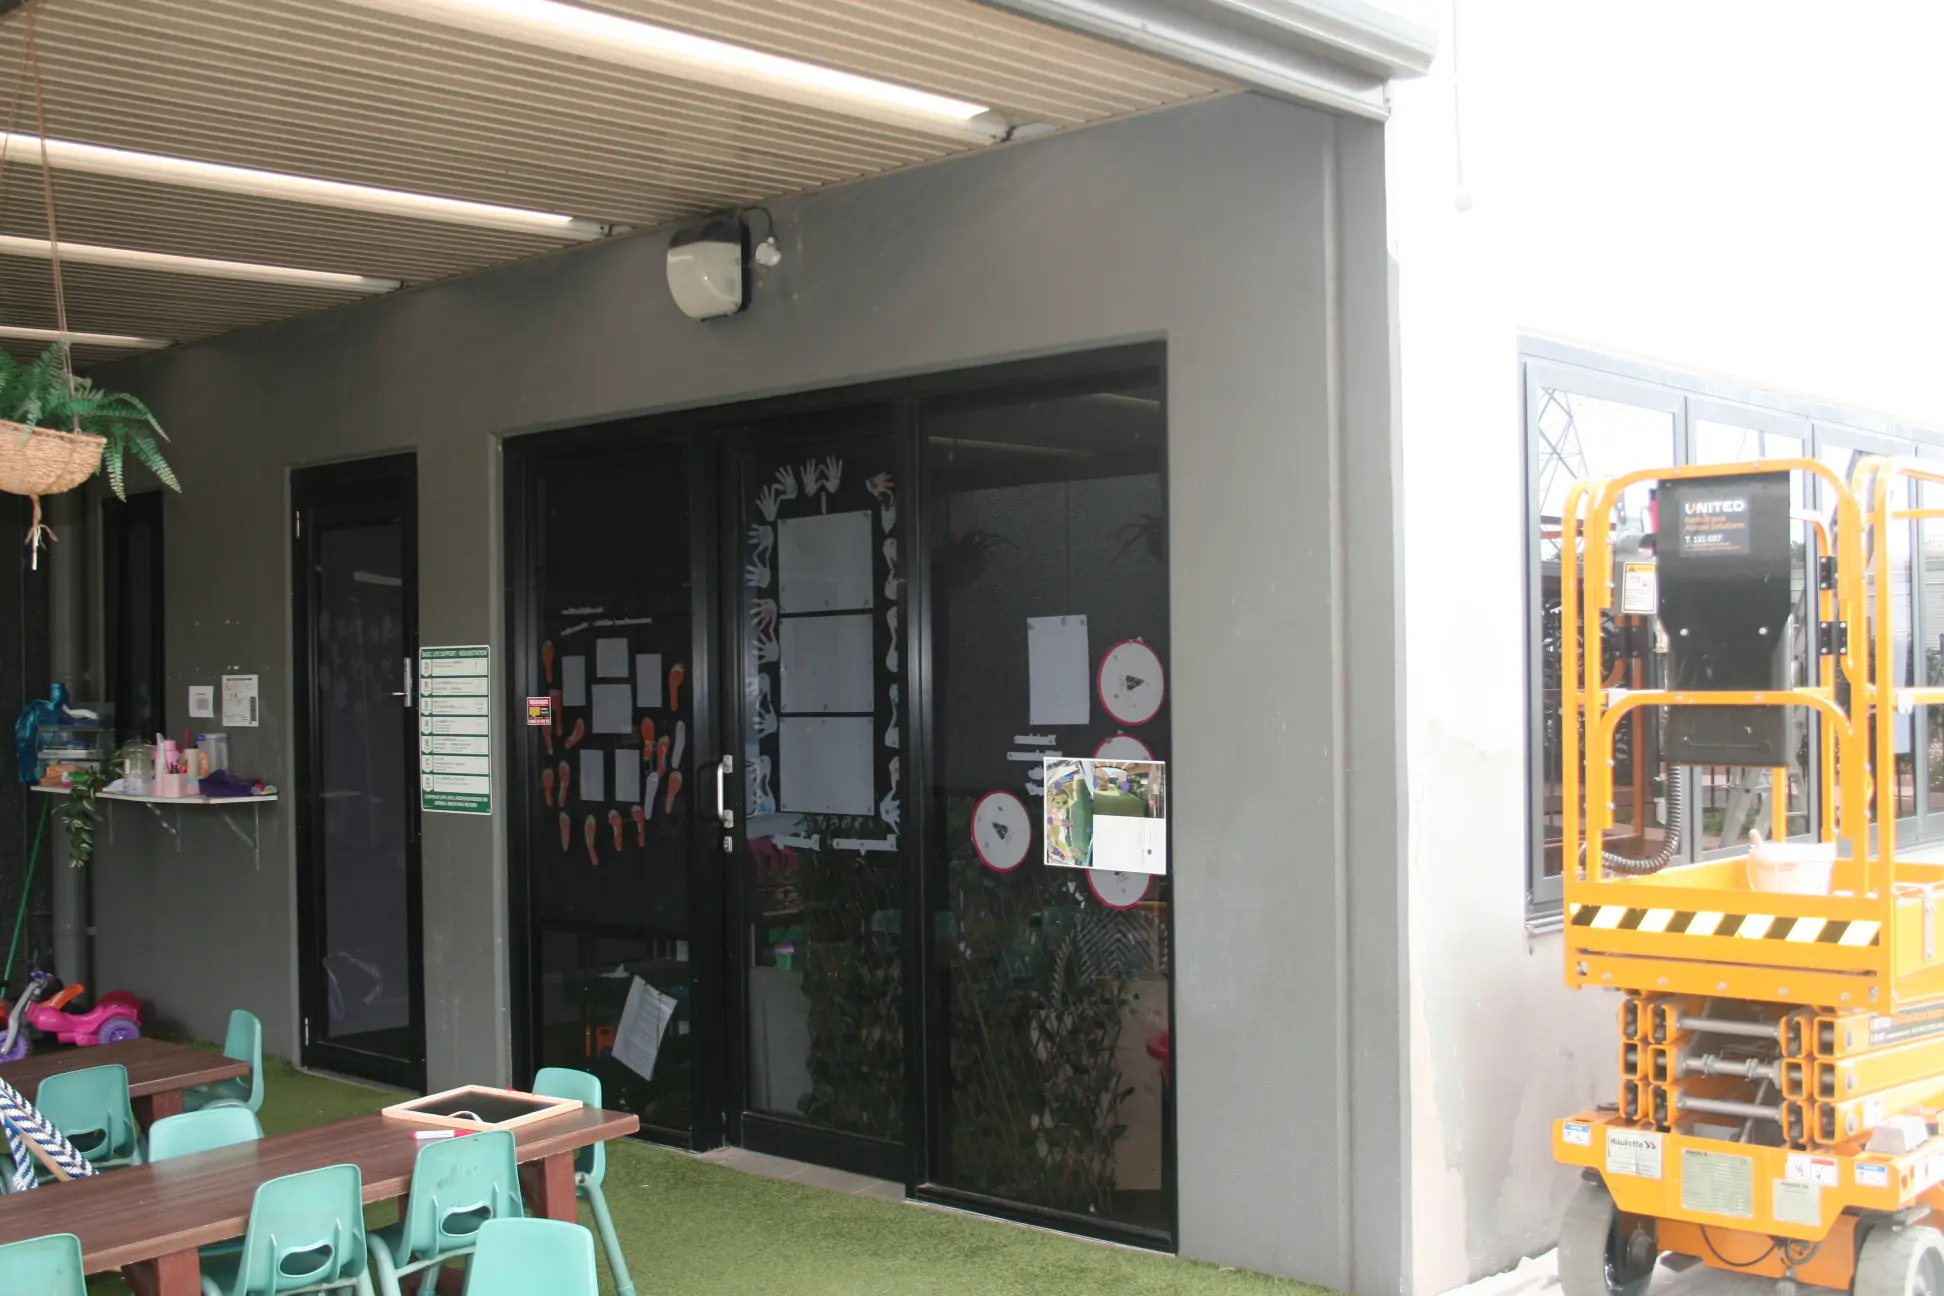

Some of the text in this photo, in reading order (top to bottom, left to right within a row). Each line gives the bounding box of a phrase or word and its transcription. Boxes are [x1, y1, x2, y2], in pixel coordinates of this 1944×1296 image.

[1684, 500, 1745, 514] UNITED
[1707, 534, 1723, 543] 607
[1610, 1138, 1644, 1148] Haulotte
